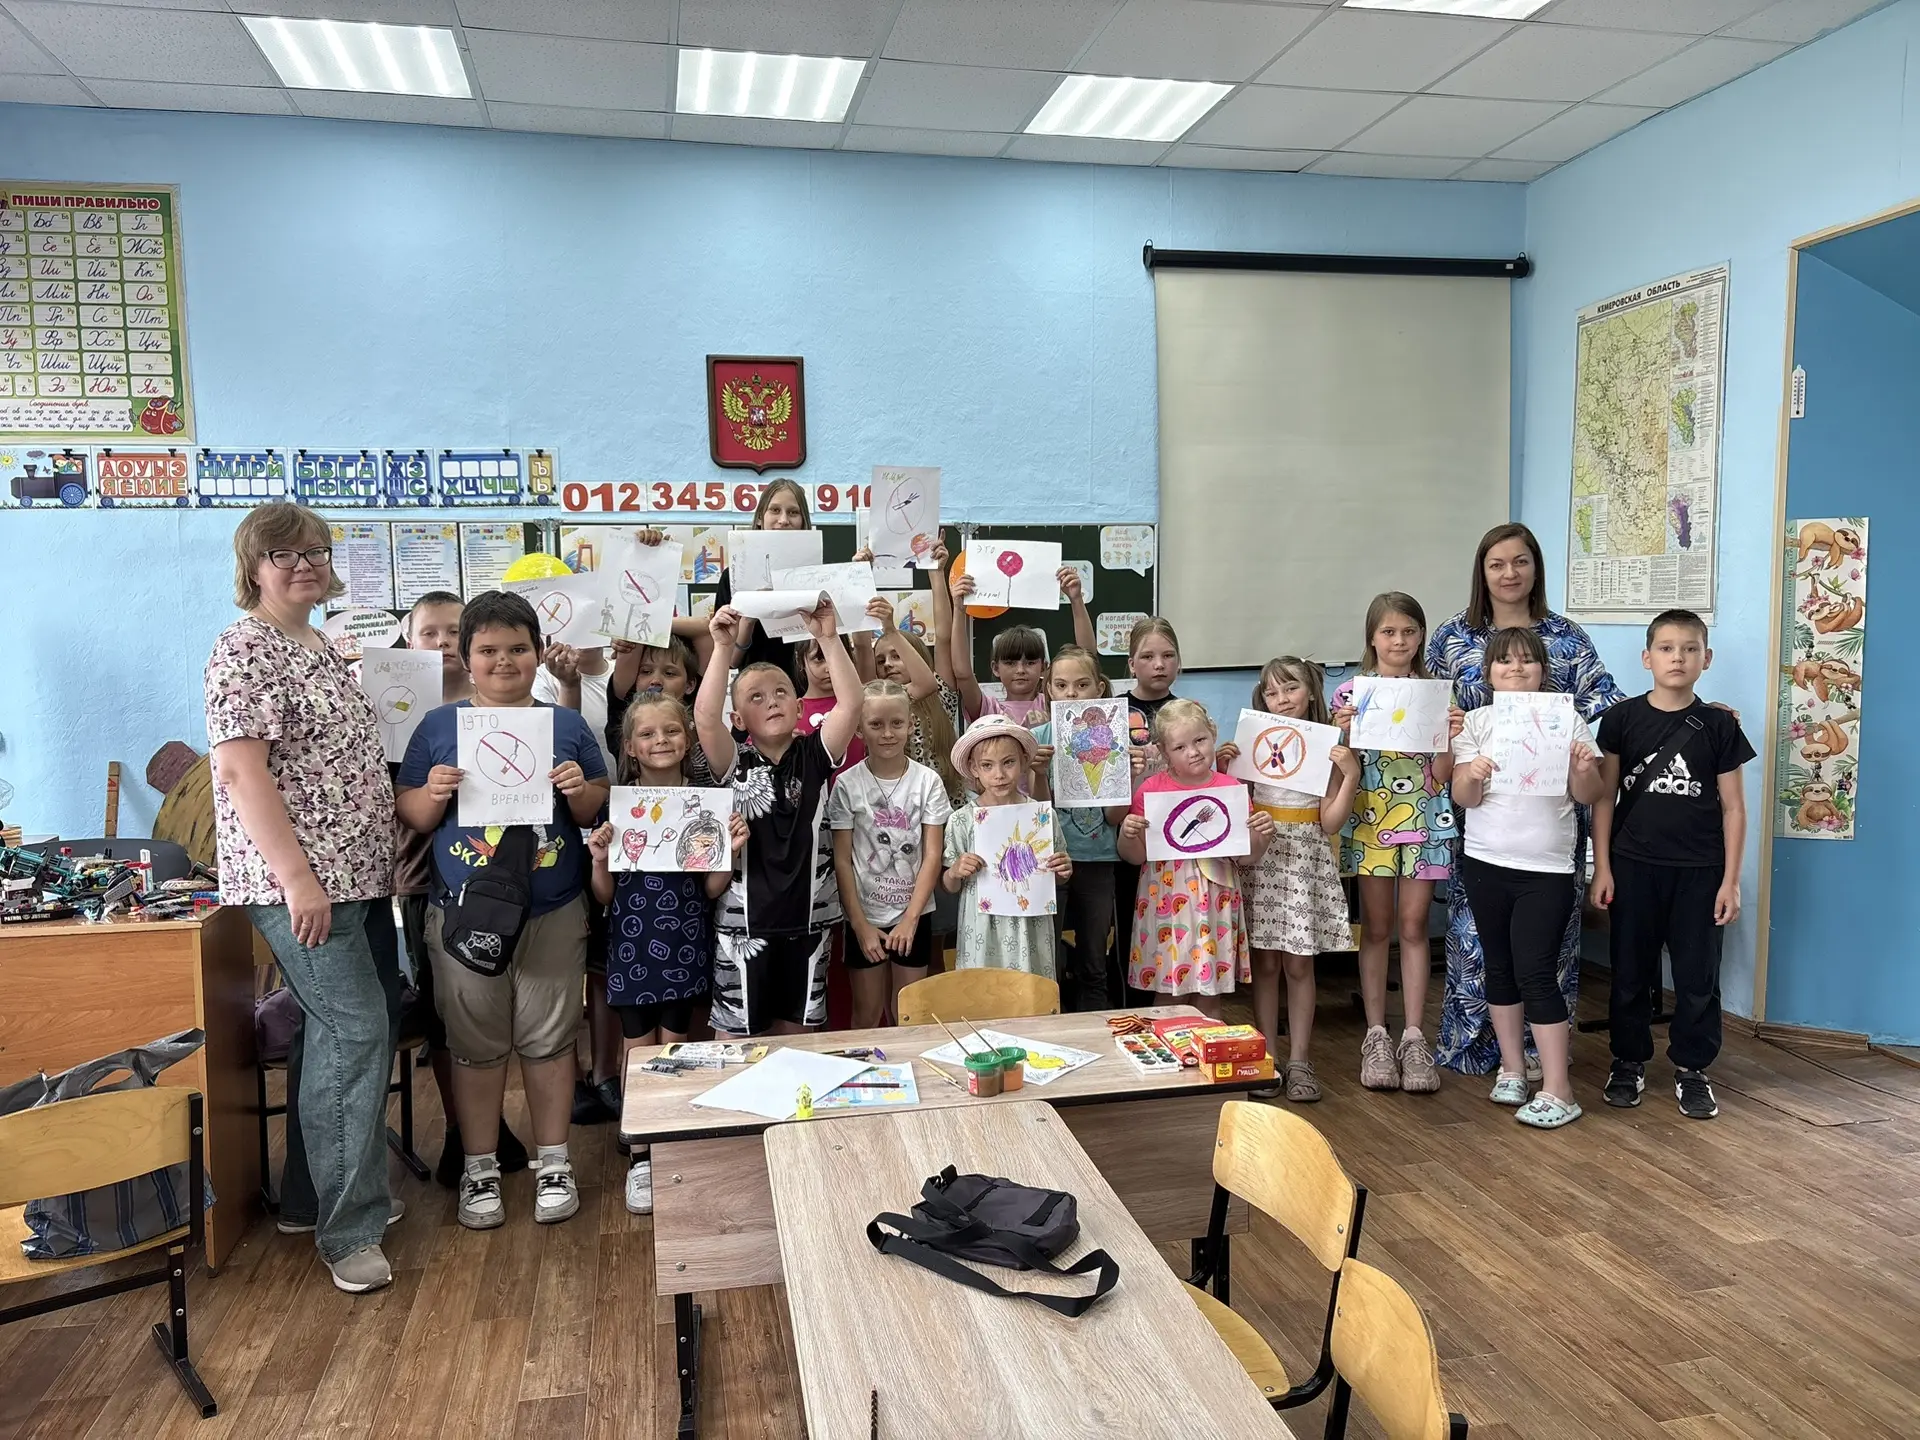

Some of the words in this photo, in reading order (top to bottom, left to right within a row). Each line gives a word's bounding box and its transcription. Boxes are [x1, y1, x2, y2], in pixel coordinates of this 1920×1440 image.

[12, 195, 60, 207] ПИШИ
[65, 196, 160, 210] ПРАВИЛЬНО
[33, 211, 59, 228] Бб
[83, 213, 103, 229] Вв
[131, 214, 150, 231] Гг
[42, 236, 58, 252] Ее
[124, 238, 163, 255] Жж
[41, 259, 61, 275] Ии
[87, 258, 108, 277] Йй
[134, 261, 154, 277] Кк
[36, 283, 71, 299] Мм
[87, 283, 110, 300] Нн
[136, 285, 154, 301] Оо
[1597, 292, 1641, 314] КЕМЕРОВСКАЯ
[1646, 280, 1681, 297] ОБЛАСТЬ
[45, 306, 65, 327] Рр
[93, 307, 108, 323] Сс
[130, 308, 163, 324] Тт
[1, 329, 17, 349] Уу
[41, 330, 63, 350] Фф
[87, 330, 115, 346] Хх
[139, 332, 162, 351] Цц
[5, 353, 22, 369] Чч
[41, 353, 71, 370] Шш
[88, 354, 121, 374] Щщ
[48, 377, 65, 392] Ээ
[89, 377, 117, 393] Юю
[137, 378, 159, 394] Яя
[344, 620, 398, 631] ВОСПОМИНАНИЯ
[352, 612, 387, 621] СОБИРАЕМ
[368, 629, 388, 637] ЛЕТО!
[884, 877, 913, 887] ТАКАЯ
[869, 891, 912, 902] МИЛАЯ
